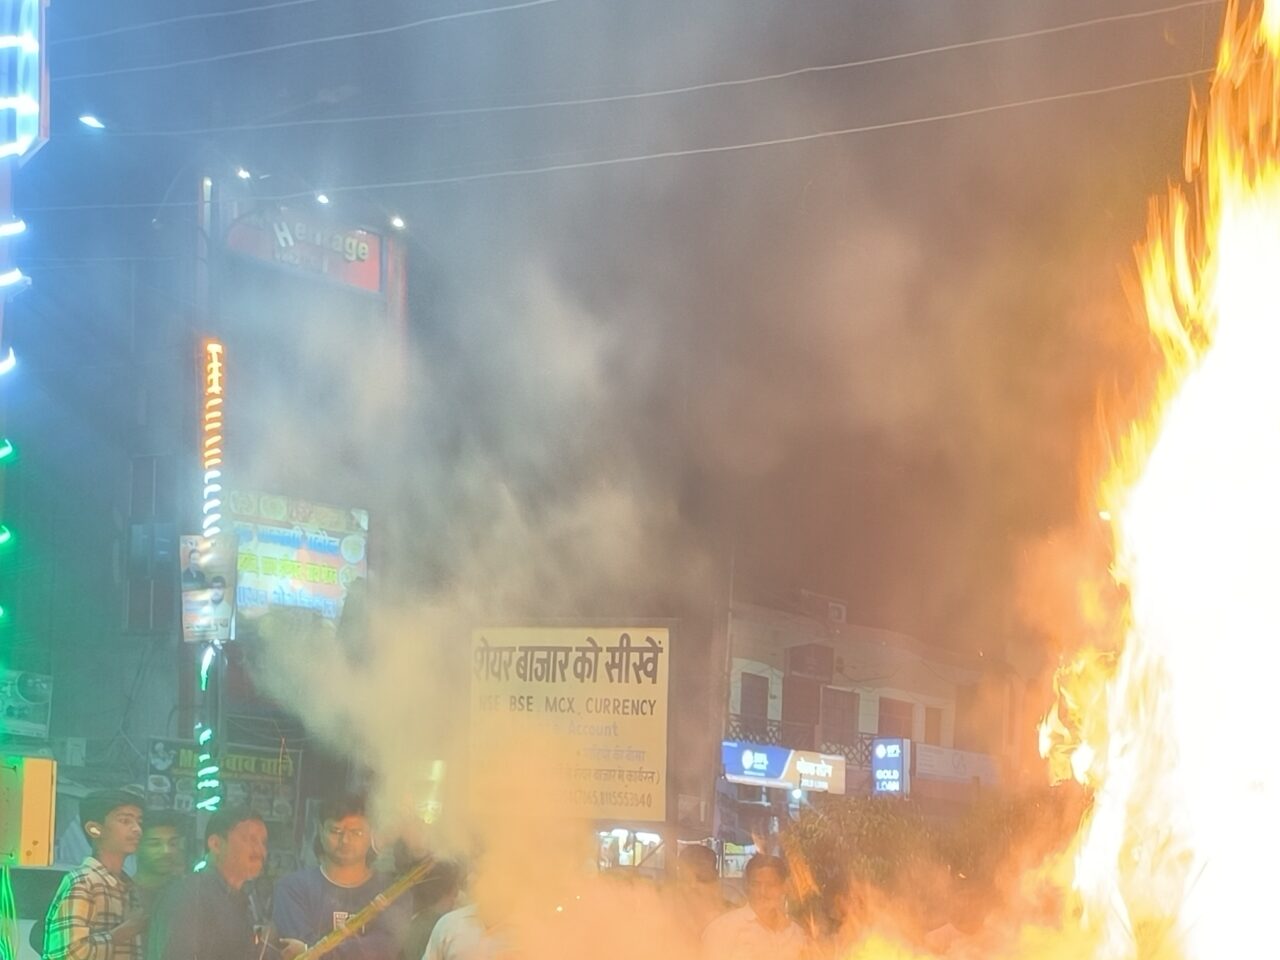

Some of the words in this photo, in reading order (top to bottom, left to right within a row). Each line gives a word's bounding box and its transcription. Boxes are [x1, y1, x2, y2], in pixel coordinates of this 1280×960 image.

[274, 221, 369, 261] Heiage
[474, 636, 516, 681] शेयर
[516, 646, 573, 682] बाजार
[573, 637, 602, 683] को
[605, 633, 663, 684] सीखें
[509, 696, 534, 712] BSE
[586, 697, 656, 715] CURRENCY
[568, 720, 618, 736] Account
